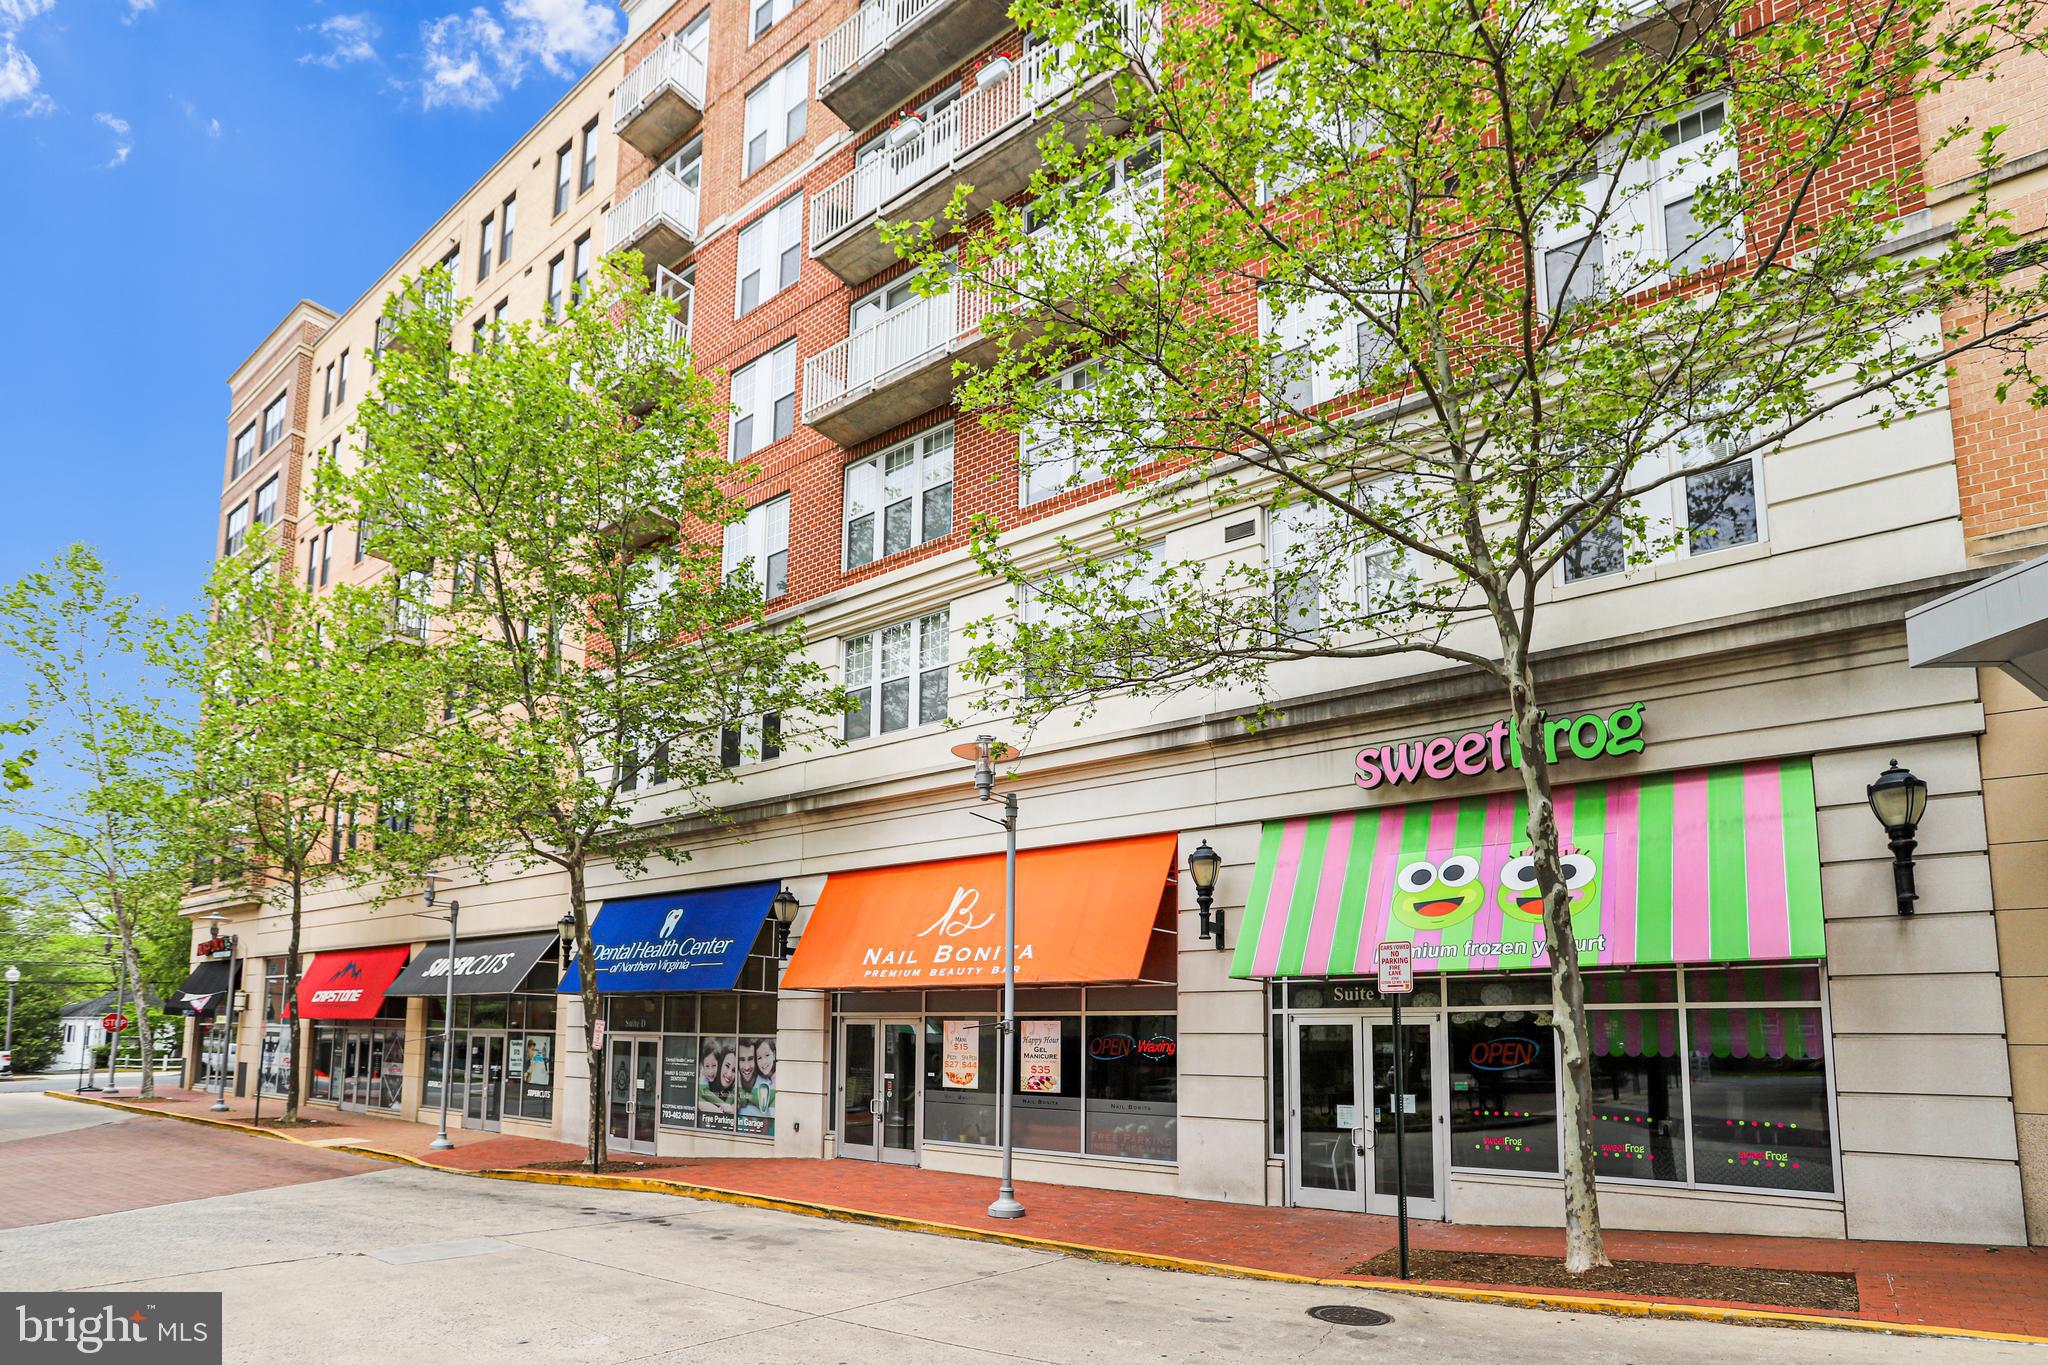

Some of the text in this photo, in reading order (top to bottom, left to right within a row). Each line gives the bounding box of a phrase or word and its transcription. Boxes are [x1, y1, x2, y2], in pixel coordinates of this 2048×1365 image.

[593, 936, 733, 961] Dental Health Center
[862, 943, 1033, 966] NAIL BONIA
[1374, 933, 1606, 965] mium frozen yurt
[609, 959, 690, 973] of Northern Virginia
[1381, 957, 1409, 965] PARKING
[864, 968, 921, 978] PREMIUM
[929, 967, 983, 977] BEAUTY
[312, 989, 364, 1003] CAPSTONE
[1334, 986, 1374, 1001] Suite
[104, 1018, 127, 1027] STP
[953, 1043, 969, 1051] $15
[1090, 1037, 1132, 1056] OPEN
[1137, 1039, 1177, 1056] Waxing
[1471, 1042, 1534, 1064] OPEN
[1023, 1052, 1058, 1060] MANICURE
[944, 1060, 977, 1069] $27 $44
[1030, 1064, 1051, 1075] $35
[702, 1114, 714, 1123] Free
[714, 1115, 734, 1126] Parking
[744, 1118, 763, 1129] Garage
